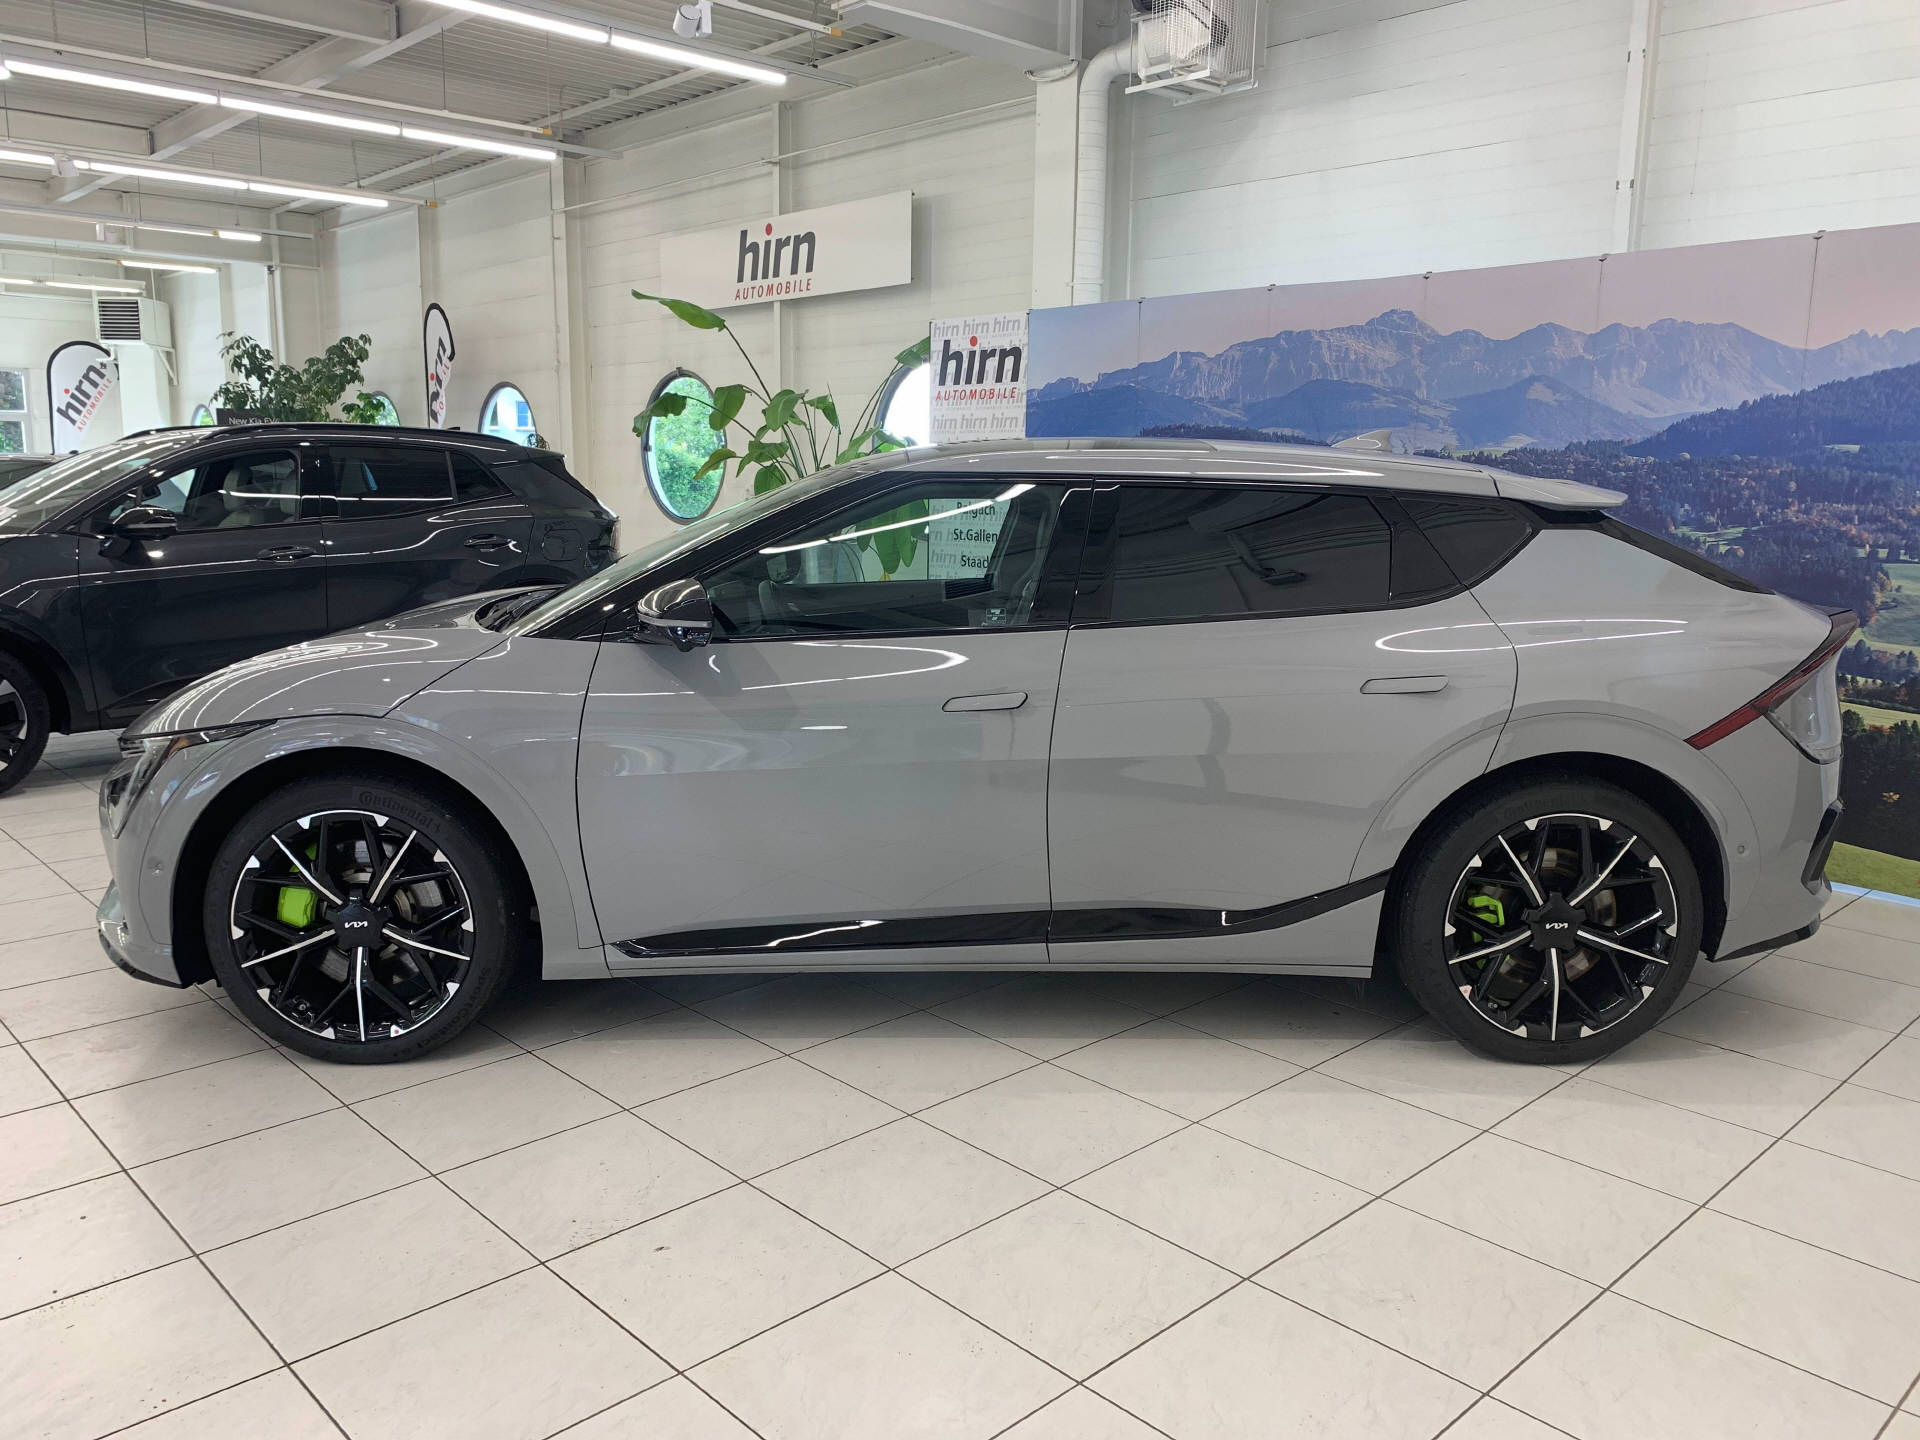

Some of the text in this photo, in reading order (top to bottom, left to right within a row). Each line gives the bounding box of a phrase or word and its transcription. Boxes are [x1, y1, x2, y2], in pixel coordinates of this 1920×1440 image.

[737, 222, 816, 283] hirn
[735, 278, 812, 300] AUTOMOBILE
[934, 316, 1020, 337] hirn hirn hirn
[939, 336, 1022, 386] hirn
[56, 365, 107, 426] hirn
[936, 387, 1017, 401] AUTOMOBILE
[77, 378, 113, 432] AUTOMOBILE
[228, 417, 248, 425] New
[961, 413, 987, 429] hirn
[991, 412, 1019, 429] hirn
[953, 528, 998, 542] St.Gallen
